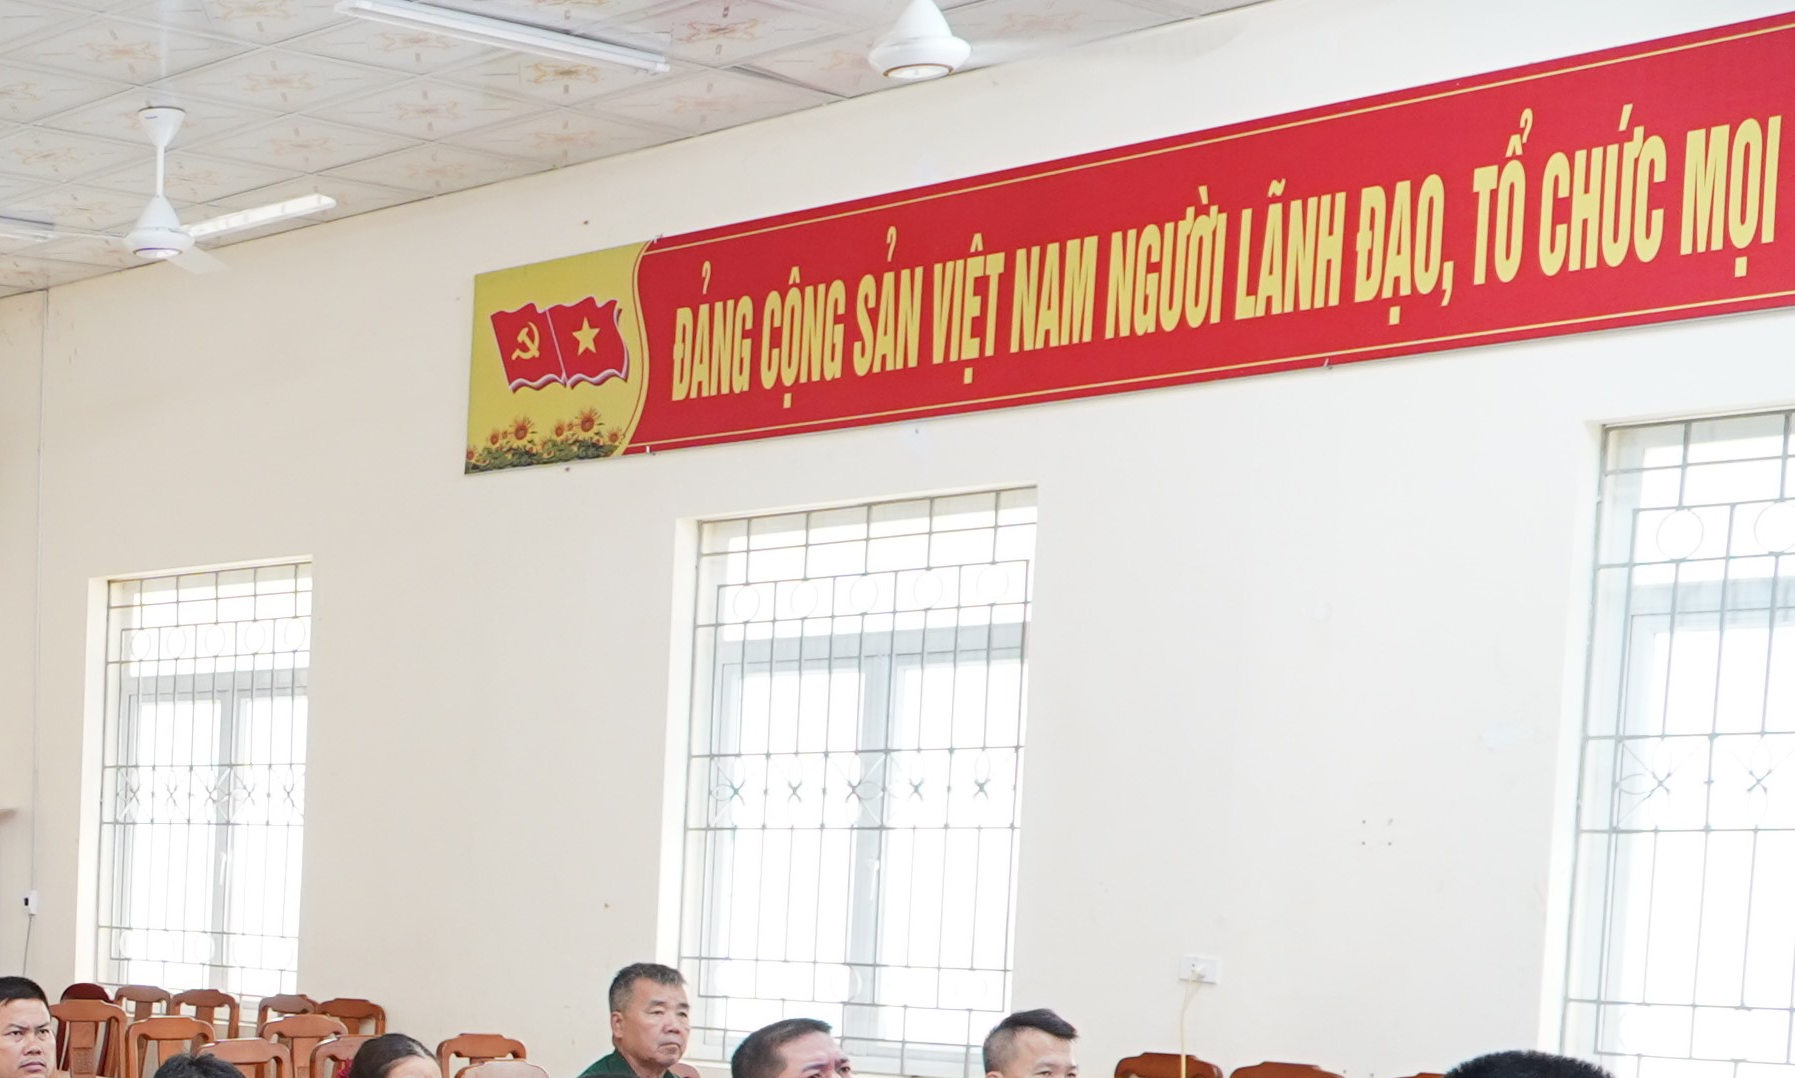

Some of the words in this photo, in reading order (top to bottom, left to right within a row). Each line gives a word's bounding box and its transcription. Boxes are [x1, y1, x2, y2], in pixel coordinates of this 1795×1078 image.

[672, 260, 753, 401] ĐẢNG
[760, 265, 846, 409] CỘNG
[853, 225, 924, 377] SẢN
[932, 232, 1006, 385] VIỆT
[1009, 235, 1100, 353] NAM
[1104, 185, 1228, 339] NGƯỜI
[1234, 177, 1347, 321] LÃNH
[1354, 173, 1455, 325] ĐẠO,
[1472, 107, 1534, 285] TỔ
[1538, 103, 1667, 277] CHỨC
[1679, 115, 1782, 278] MỌI
